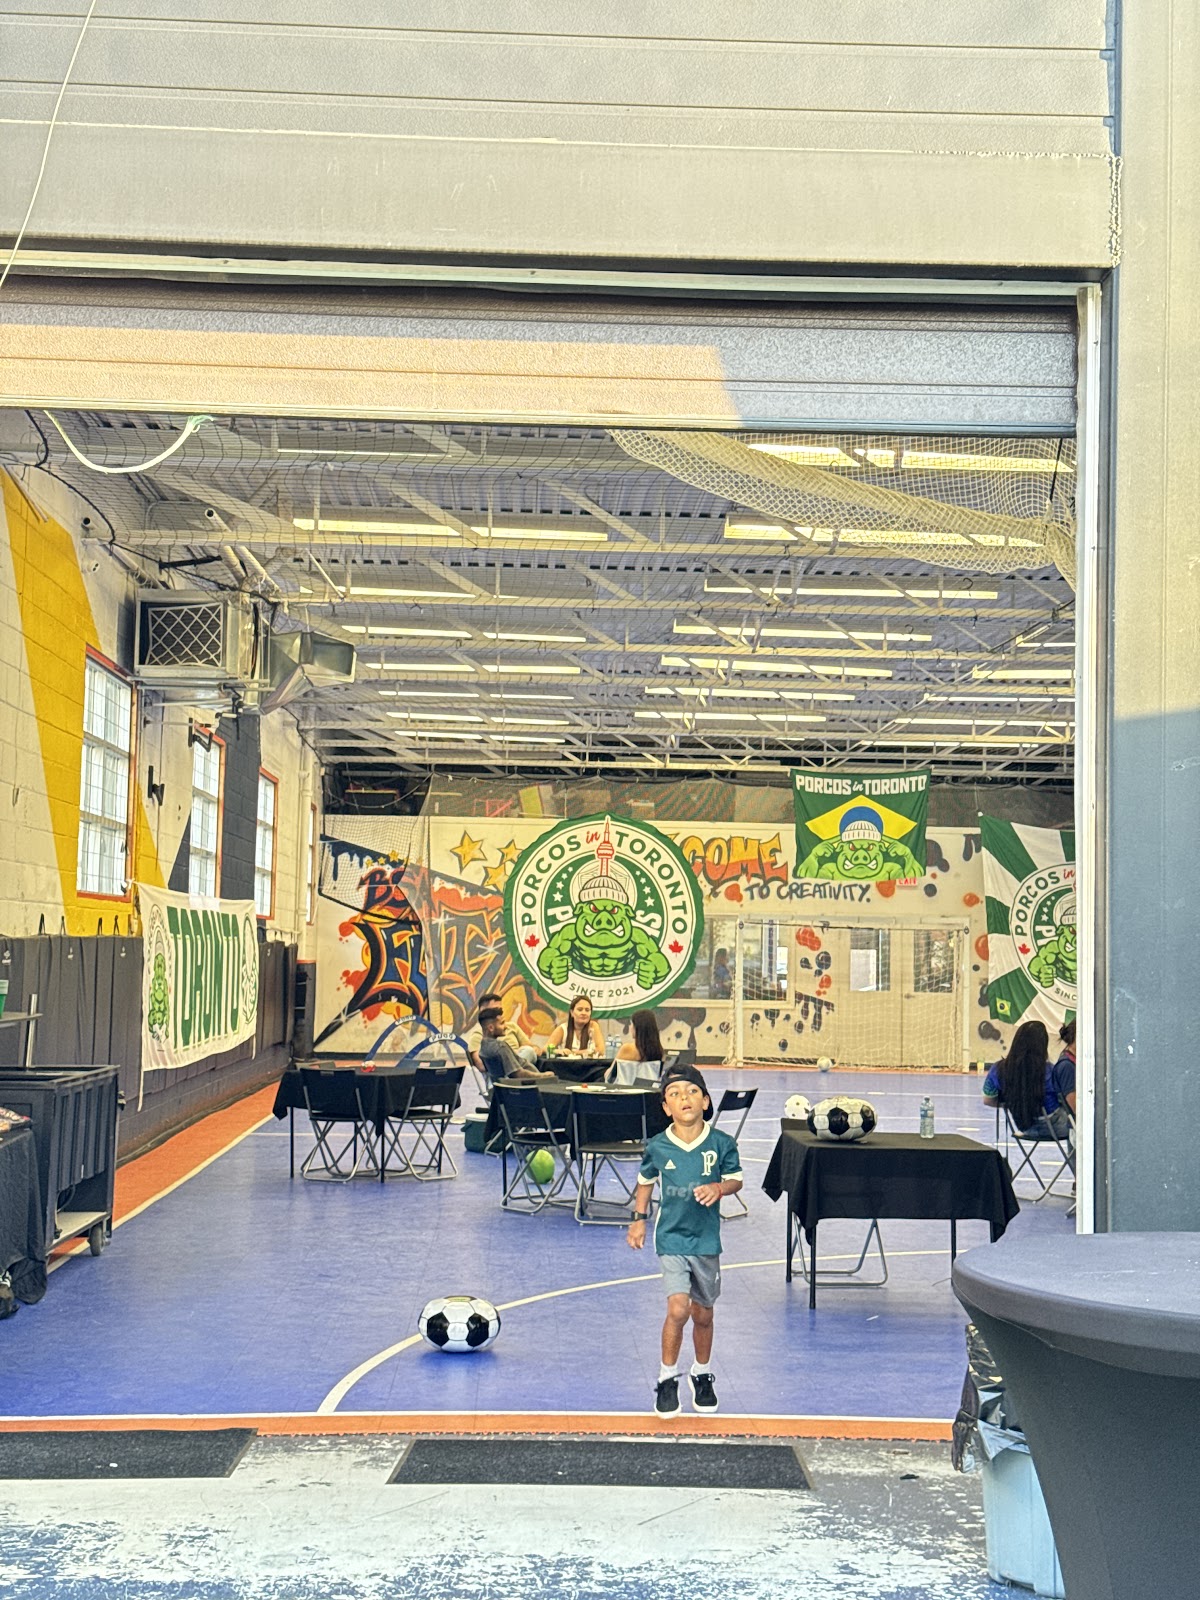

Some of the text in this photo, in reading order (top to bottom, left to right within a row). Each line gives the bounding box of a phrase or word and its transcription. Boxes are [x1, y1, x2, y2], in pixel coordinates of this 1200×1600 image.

[795, 774, 928, 796] PORCOS in TORONTO
[667, 832, 789, 886] COME
[521, 830, 688, 935] PORCOS in TORONTO
[744, 881, 872, 903] TO CREATIVITY.
[1014, 871, 1060, 937] PORCOS
[166, 905, 240, 1052] TORONTO
[569, 982, 635, 998] SINCE 2021
[1054, 987, 1077, 1001] SINC
